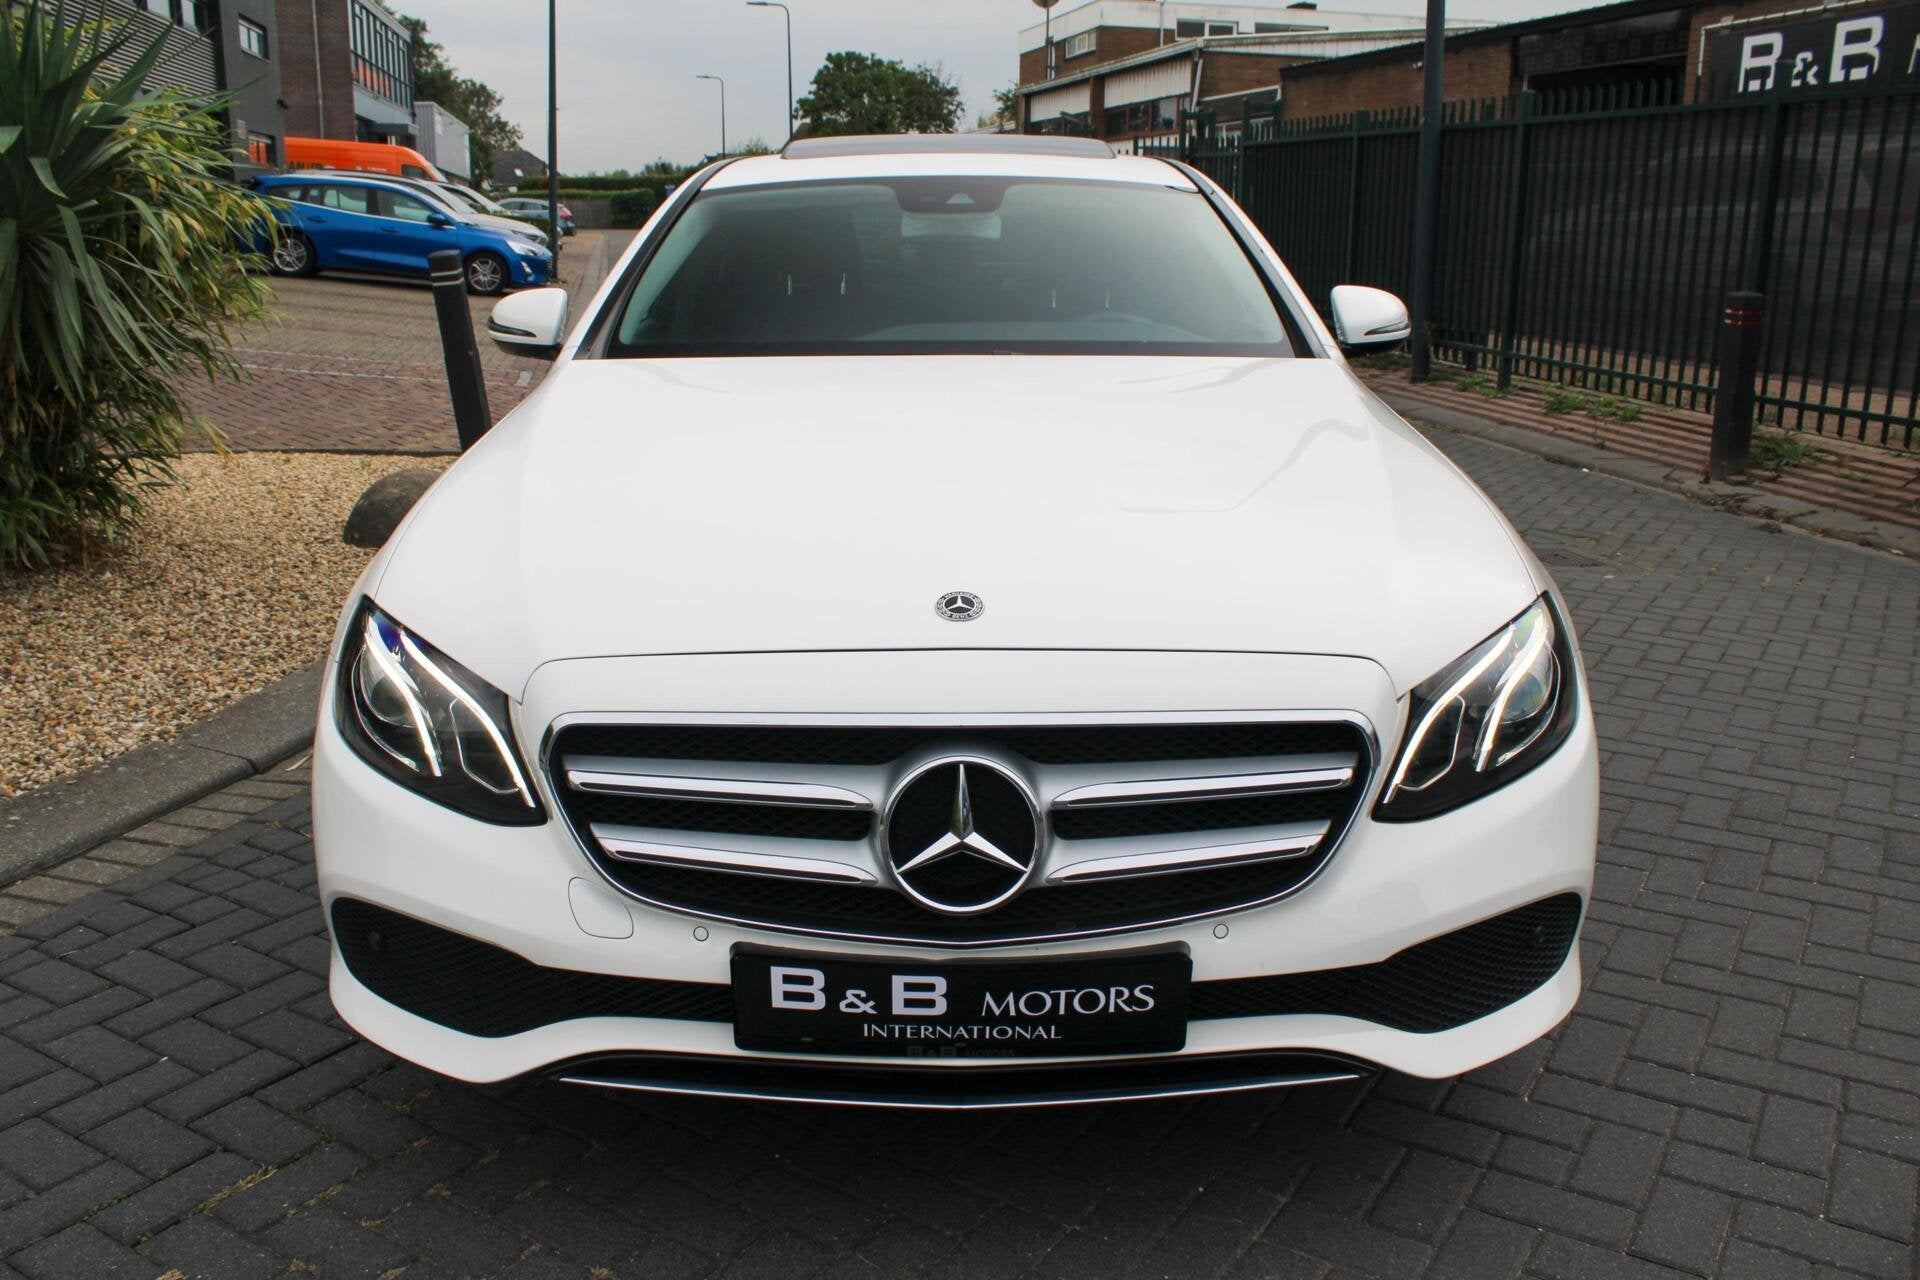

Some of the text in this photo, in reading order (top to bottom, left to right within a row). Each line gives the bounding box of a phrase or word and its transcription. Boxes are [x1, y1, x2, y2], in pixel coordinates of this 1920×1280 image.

[1829, 16, 1884, 83] B
[770, 965, 1155, 1017] B & B MOTORS
[863, 1023, 1062, 1039] INTERNATIONAL
